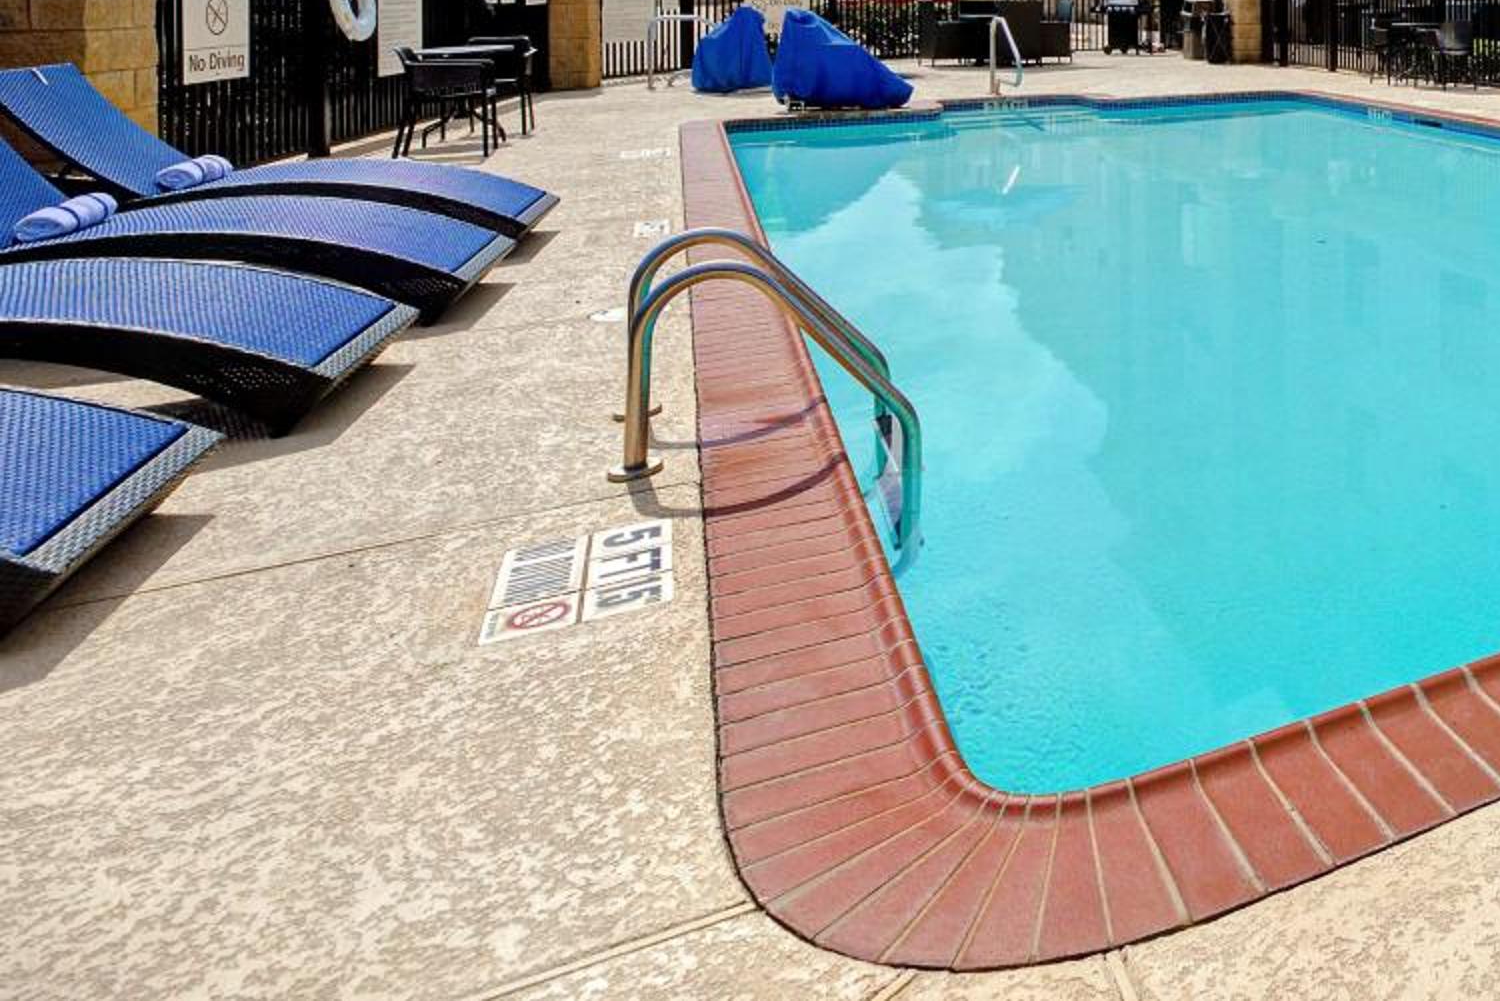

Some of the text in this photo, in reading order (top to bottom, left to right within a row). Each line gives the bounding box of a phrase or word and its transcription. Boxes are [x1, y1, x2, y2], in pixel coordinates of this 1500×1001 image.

[189, 49, 245, 72] No Diving
[602, 525, 662, 548] 5
[600, 547, 662, 579] FT
